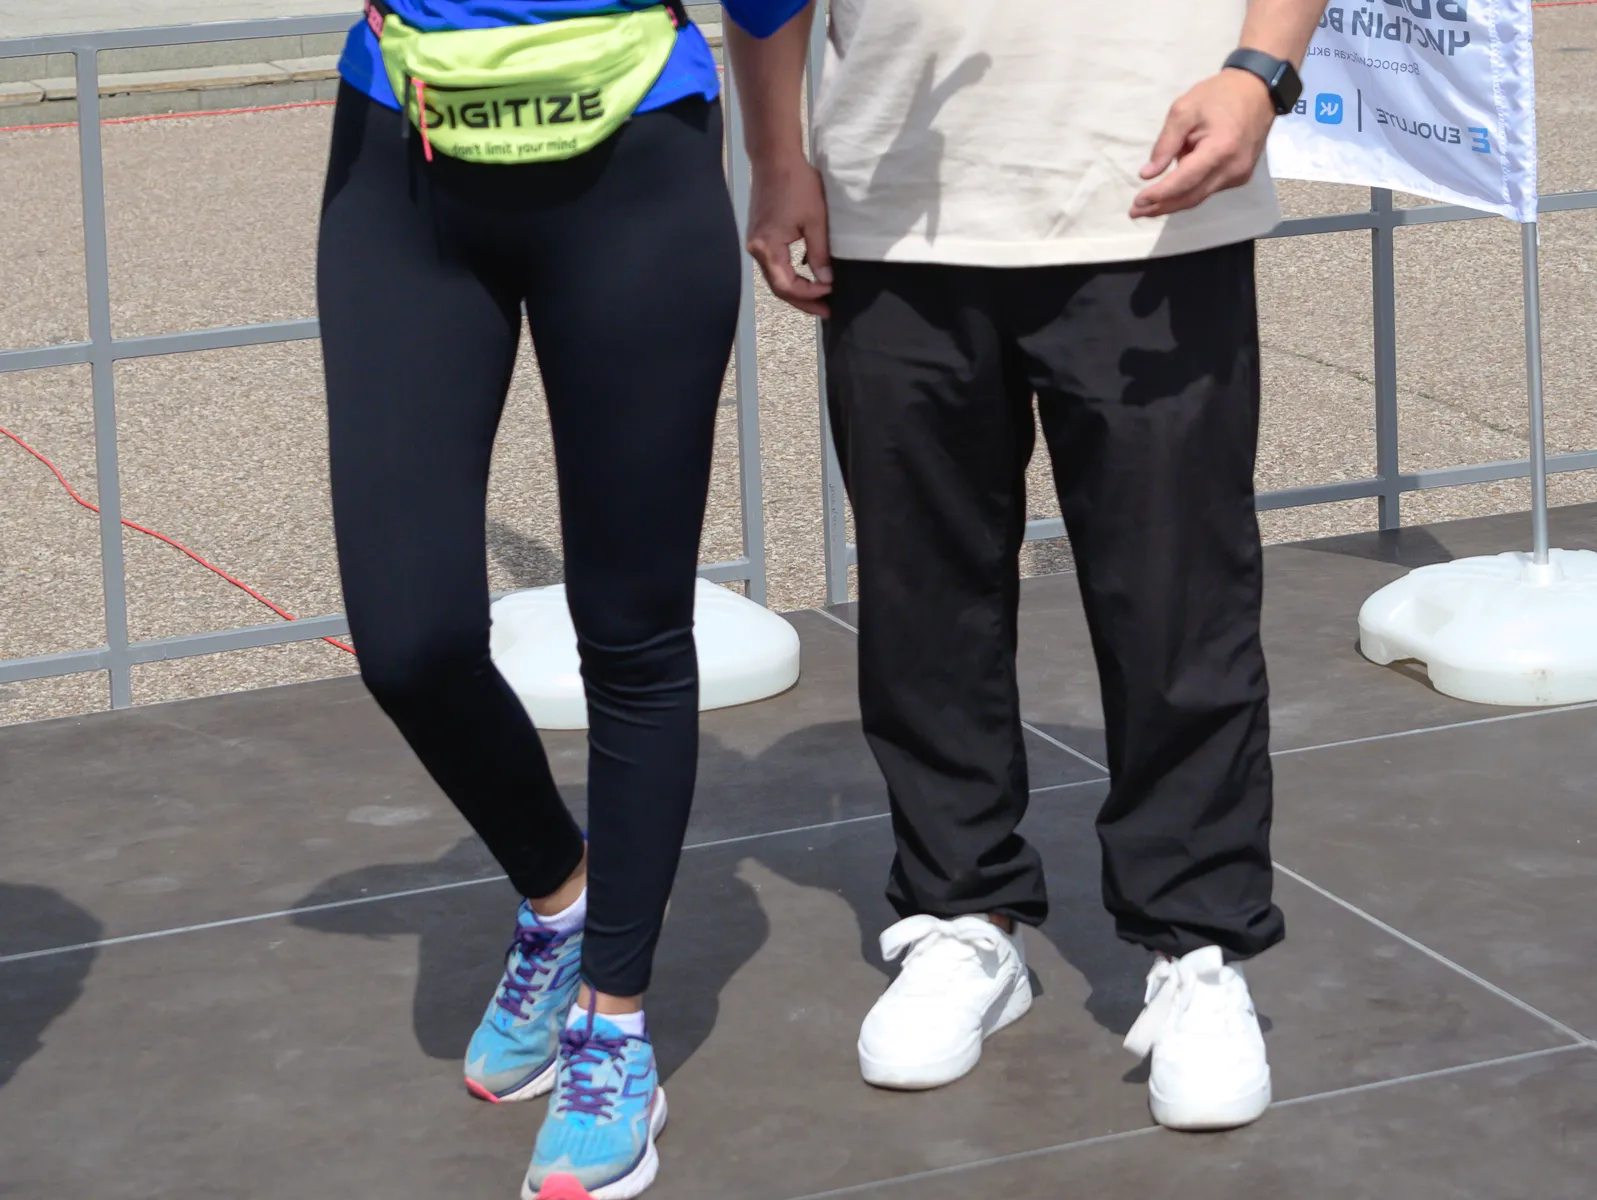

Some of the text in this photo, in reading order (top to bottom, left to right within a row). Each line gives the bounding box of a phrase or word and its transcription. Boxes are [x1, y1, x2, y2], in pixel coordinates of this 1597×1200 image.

[419, 90, 605, 131] DIGITIZE
[485, 141, 512, 155] limit
[517, 142, 542, 157] your
[547, 137, 578, 151] mind
